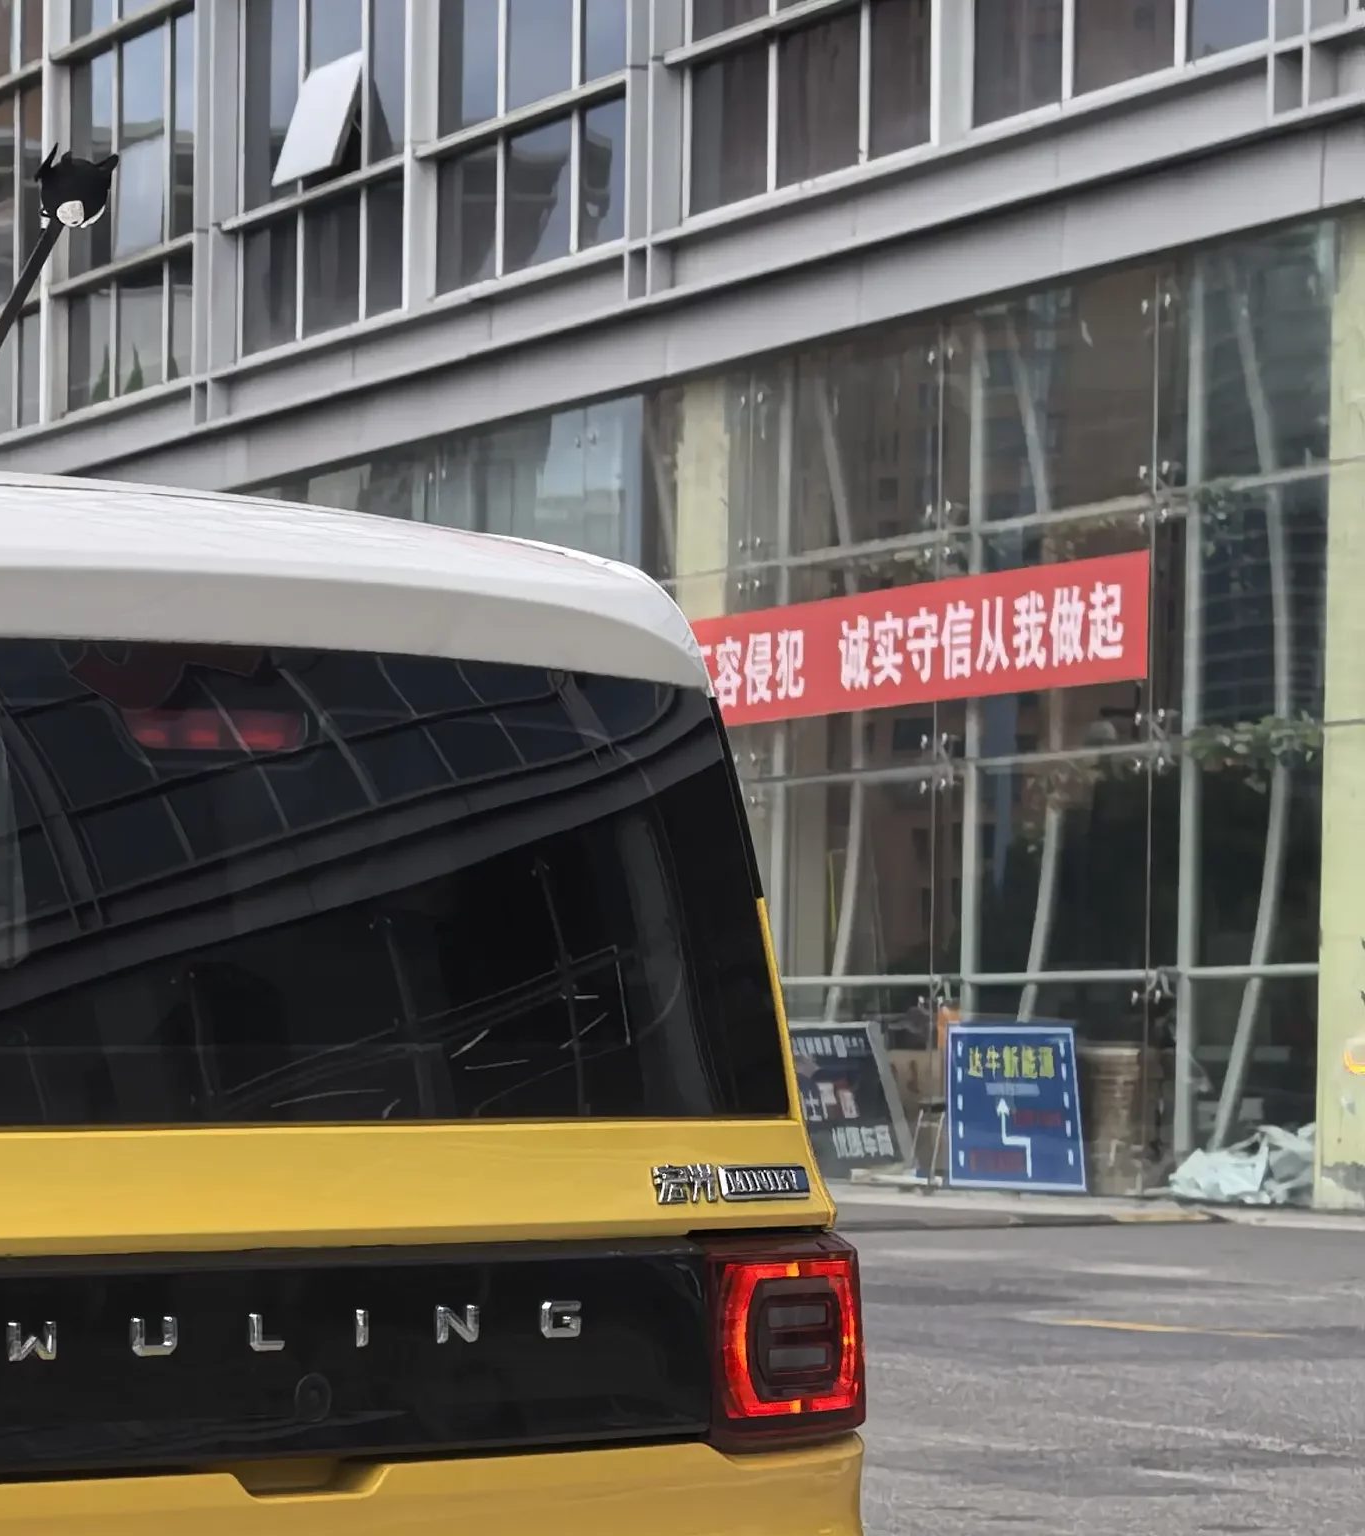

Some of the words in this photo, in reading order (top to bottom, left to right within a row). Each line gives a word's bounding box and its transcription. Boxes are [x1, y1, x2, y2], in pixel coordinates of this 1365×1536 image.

[838, 581, 1125, 692] 诚实守信从我做起
[6, 1301, 582, 1362] WULING
